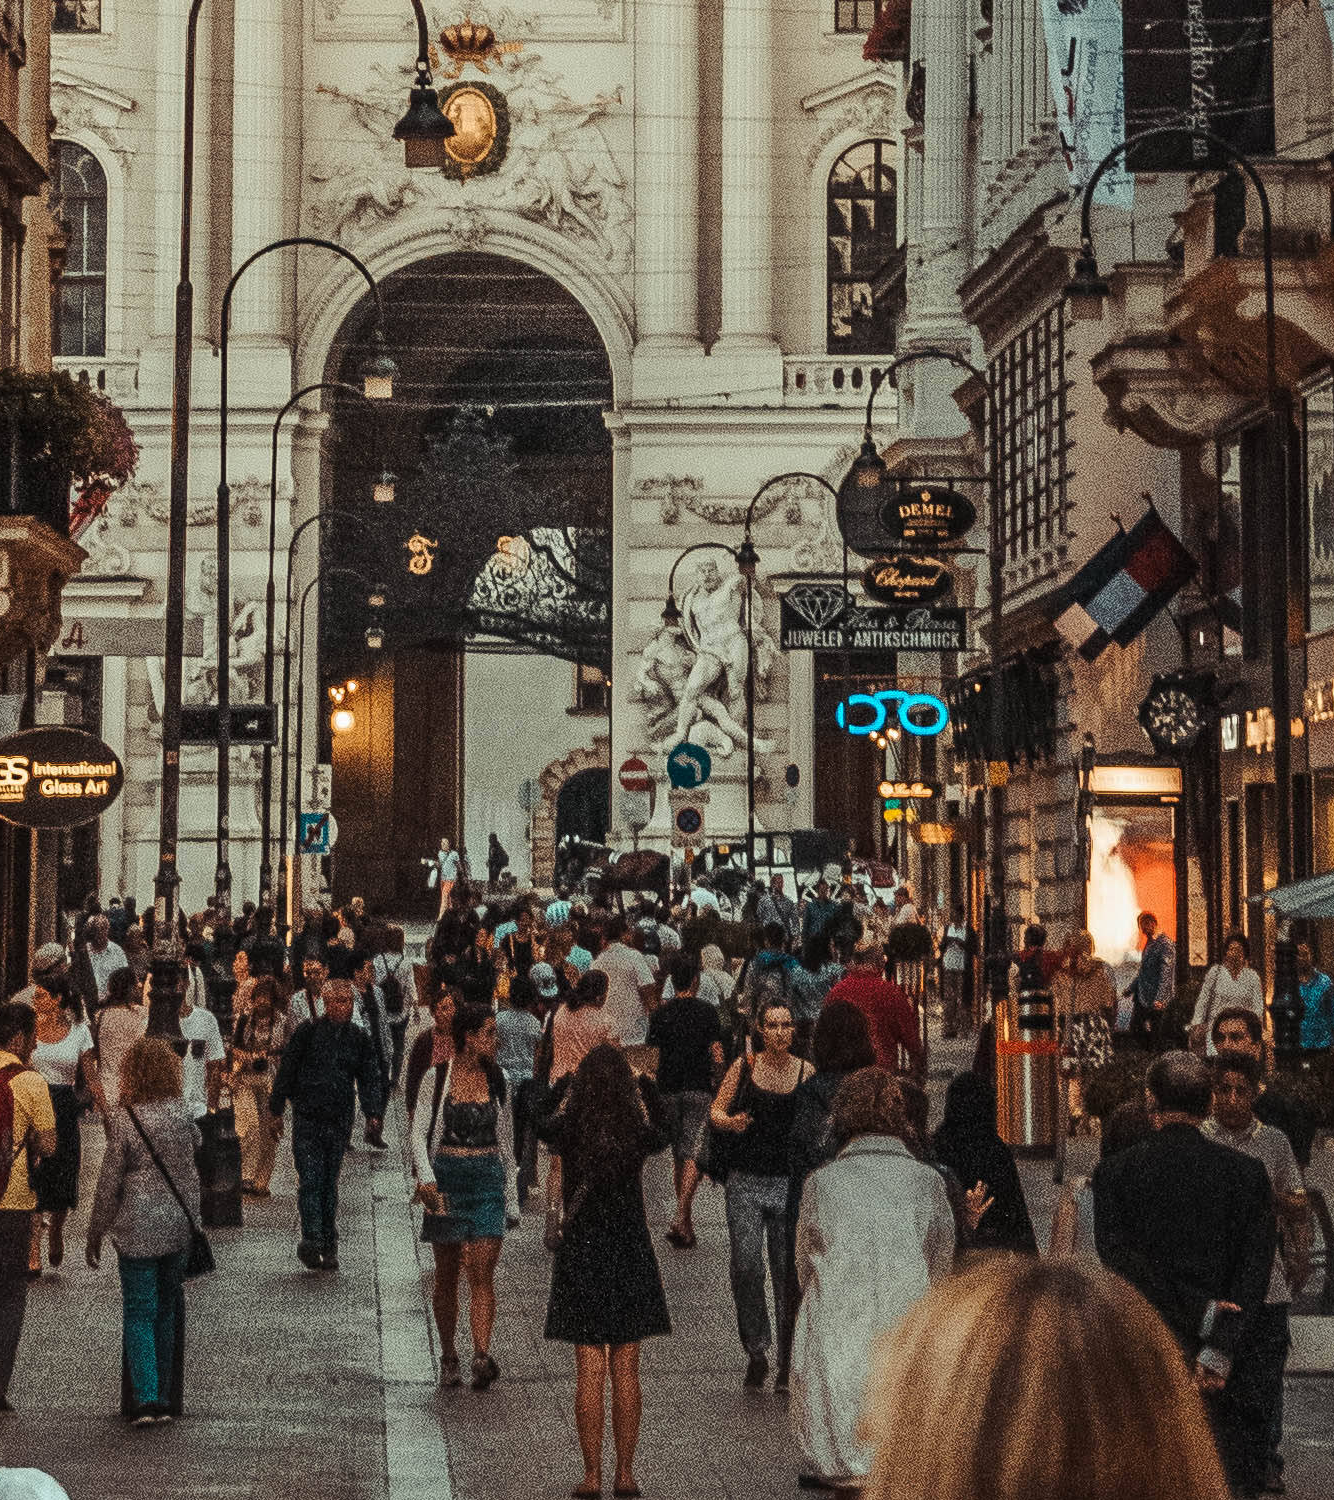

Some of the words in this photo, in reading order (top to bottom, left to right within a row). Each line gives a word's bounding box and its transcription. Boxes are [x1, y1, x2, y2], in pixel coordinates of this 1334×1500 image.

[853, 629, 960, 649] ANTIKSCHMUCK
[32, 760, 117, 778] International
[40, 778, 83, 797] Glass
[84, 777, 109, 797] Art
